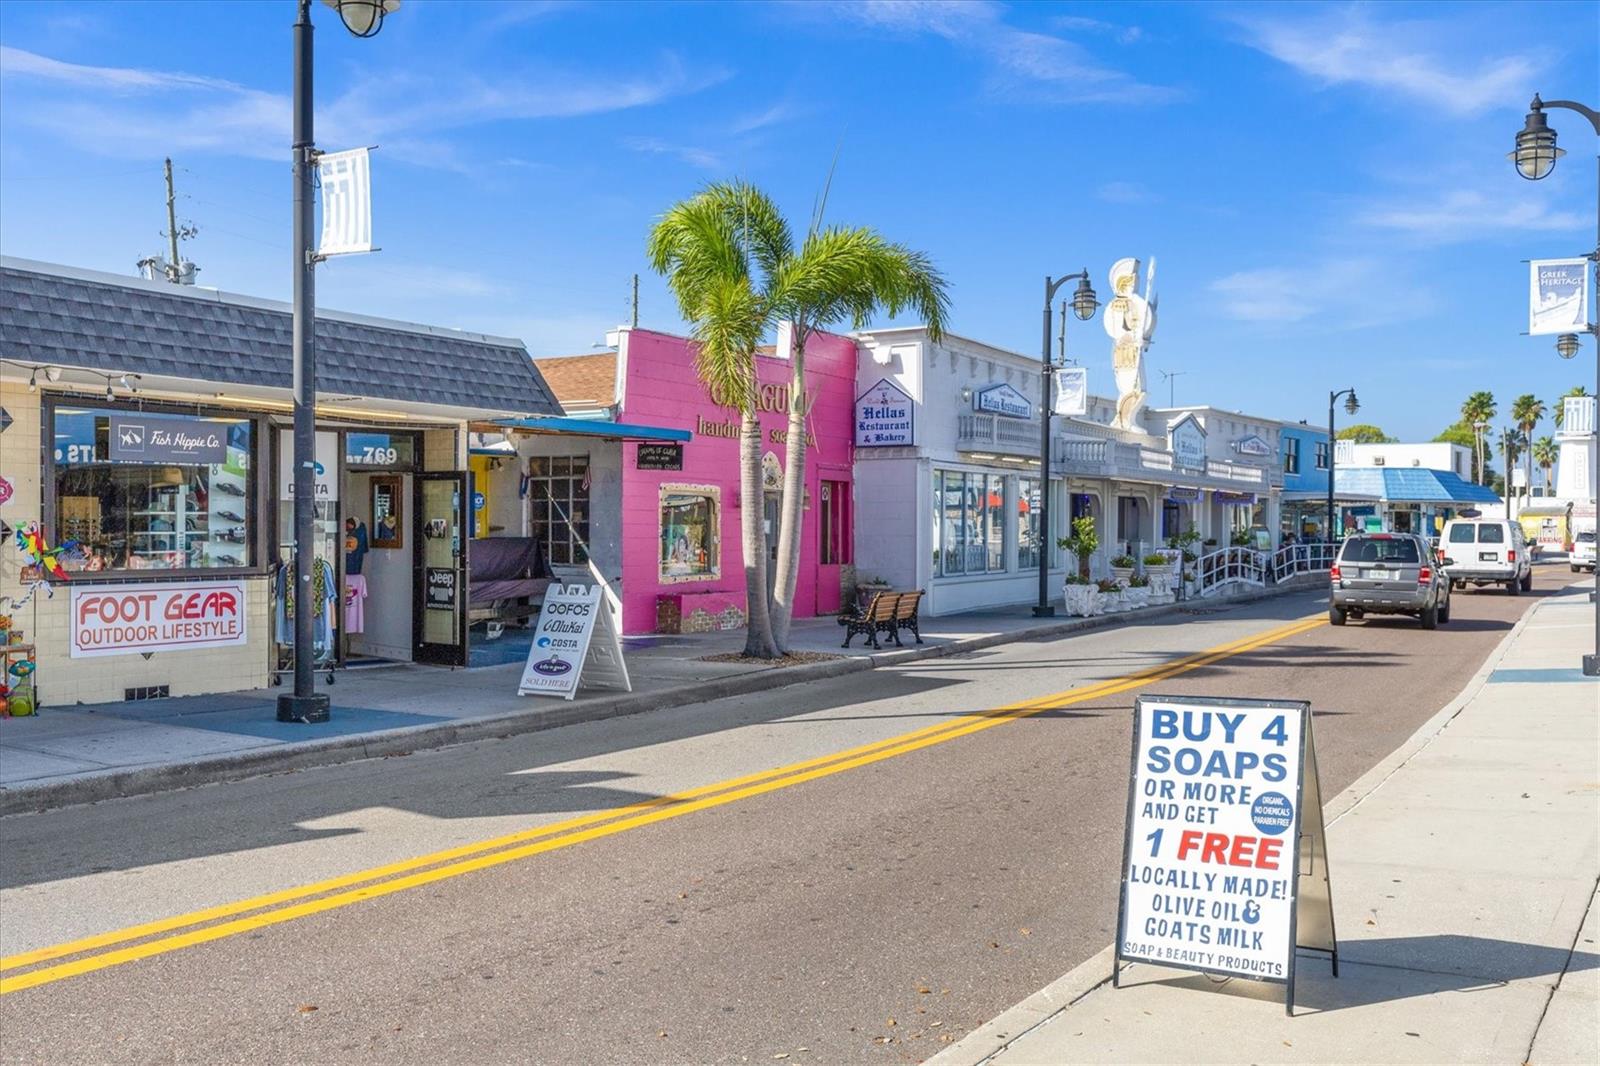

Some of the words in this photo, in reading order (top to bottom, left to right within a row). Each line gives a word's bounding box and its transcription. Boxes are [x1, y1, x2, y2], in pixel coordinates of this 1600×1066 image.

[1541, 271, 1568, 279] GREEK
[1541, 278, 1582, 287] HERITAGE
[863, 407, 905, 419] Hellas
[859, 421, 909, 431] Restaurant
[150, 430, 171, 446] Fish
[173, 432, 206, 450] Hippie
[206, 434, 220, 448] Co.
[864, 435, 870, 443] &
[875, 433, 905, 442] Bakery
[363, 446, 397, 464] 769
[288, 484, 328, 494] CTA
[430, 570, 454, 587] Jeep
[80, 594, 158, 625] FOOT
[164, 591, 237, 620] GEAR
[547, 603, 590, 616] OOFOS
[80, 625, 158, 645] OUTDOOR
[162, 620, 237, 640] LIFESTYLE
[551, 620, 585, 634] OluKai
[551, 639, 578, 648] COSTA
[1151, 709, 1247, 744] BUY
[1261, 715, 1289, 746] 4
[1146, 745, 1288, 783] SOAPS
[1144, 778, 1176, 800] OR
[1183, 782, 1252, 805] MORE
[1142, 802, 1179, 821] AND
[1184, 805, 1219, 825] GET
[1255, 806, 1262, 814] NO
[1146, 828, 1164, 858] 1
[1177, 830, 1284, 871] FREE
[1131, 864, 1217, 892] LOCALLY
[1223, 876, 1288, 900] MADE!
[1152, 894, 1206, 918] OLIVE
[1144, 917, 1211, 945] GOATS
[1216, 927, 1264, 951] MILK
[1123, 942, 1155, 957] SOAP
[1156, 947, 1163, 957] &
[1165, 947, 1215, 965] BEAUTY
[1218, 955, 1283, 976] PRODUCTS
